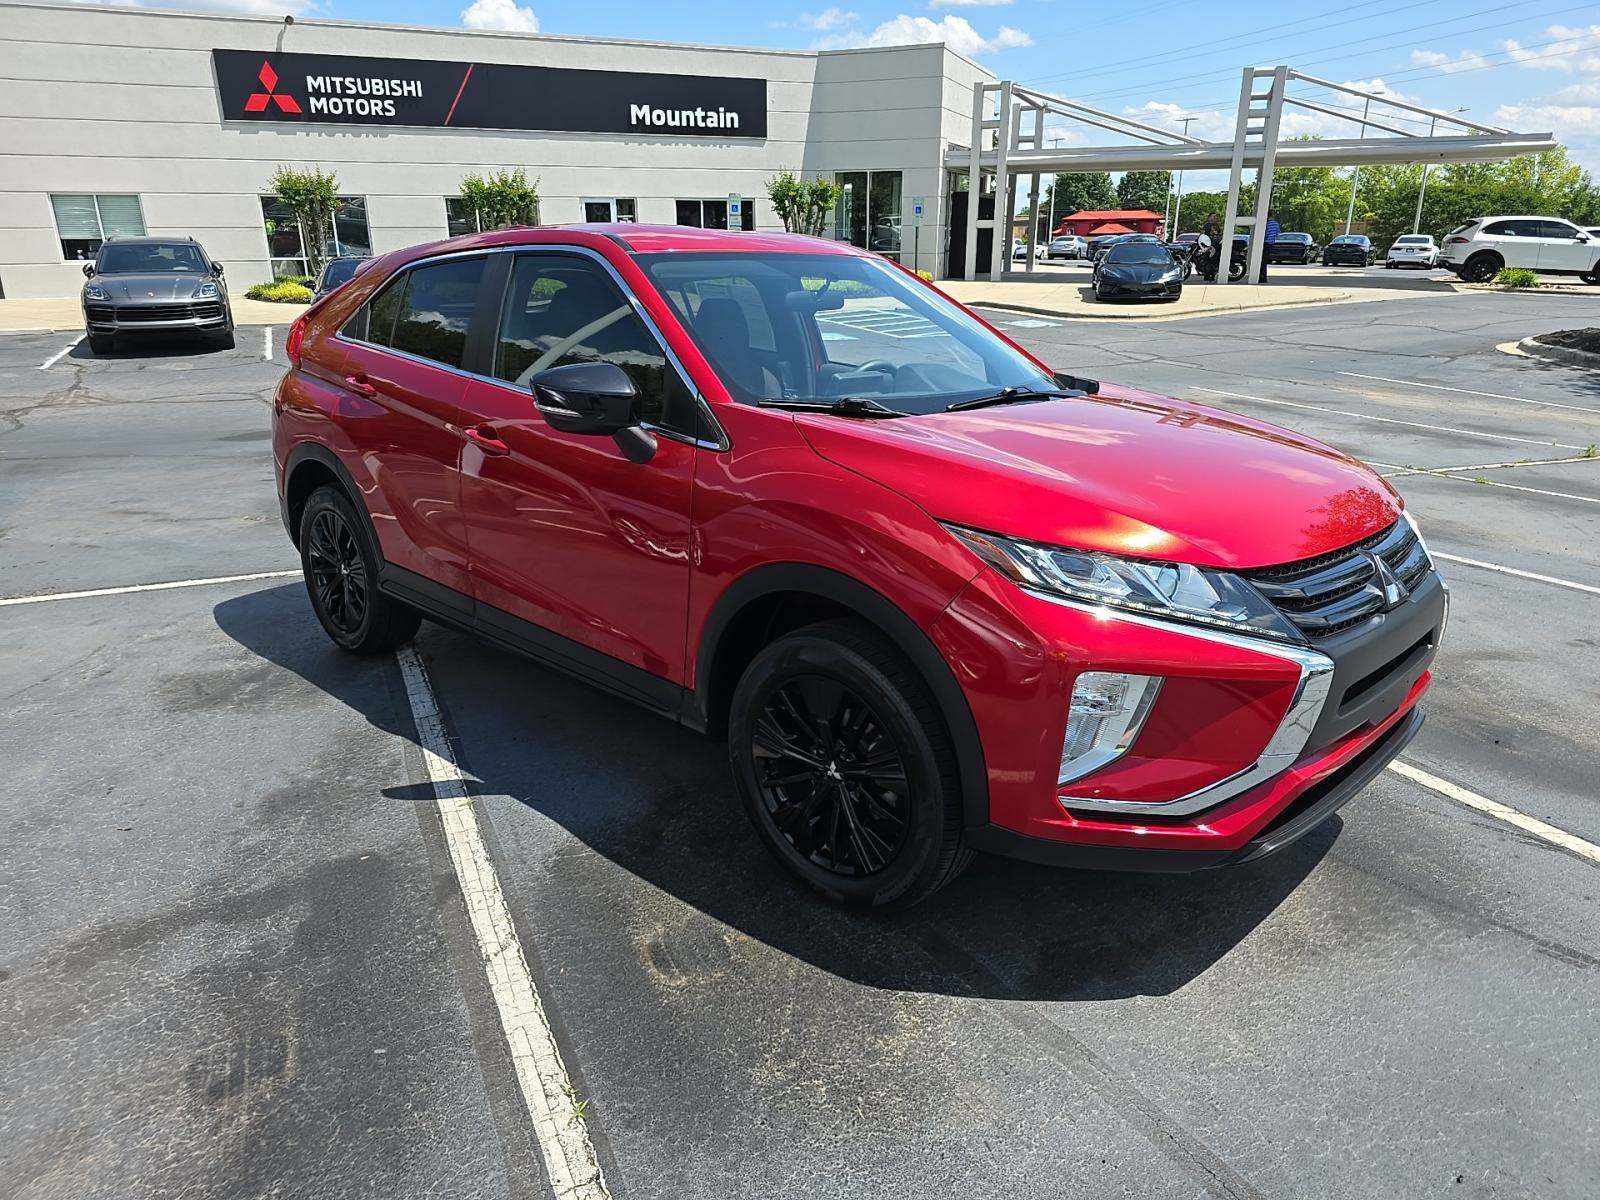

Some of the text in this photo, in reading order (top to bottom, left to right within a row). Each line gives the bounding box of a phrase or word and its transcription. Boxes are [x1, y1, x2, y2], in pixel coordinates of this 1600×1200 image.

[306, 75, 423, 97] MITSUBISHI
[309, 97, 396, 117] MOTORS
[630, 104, 739, 128] Mountain
